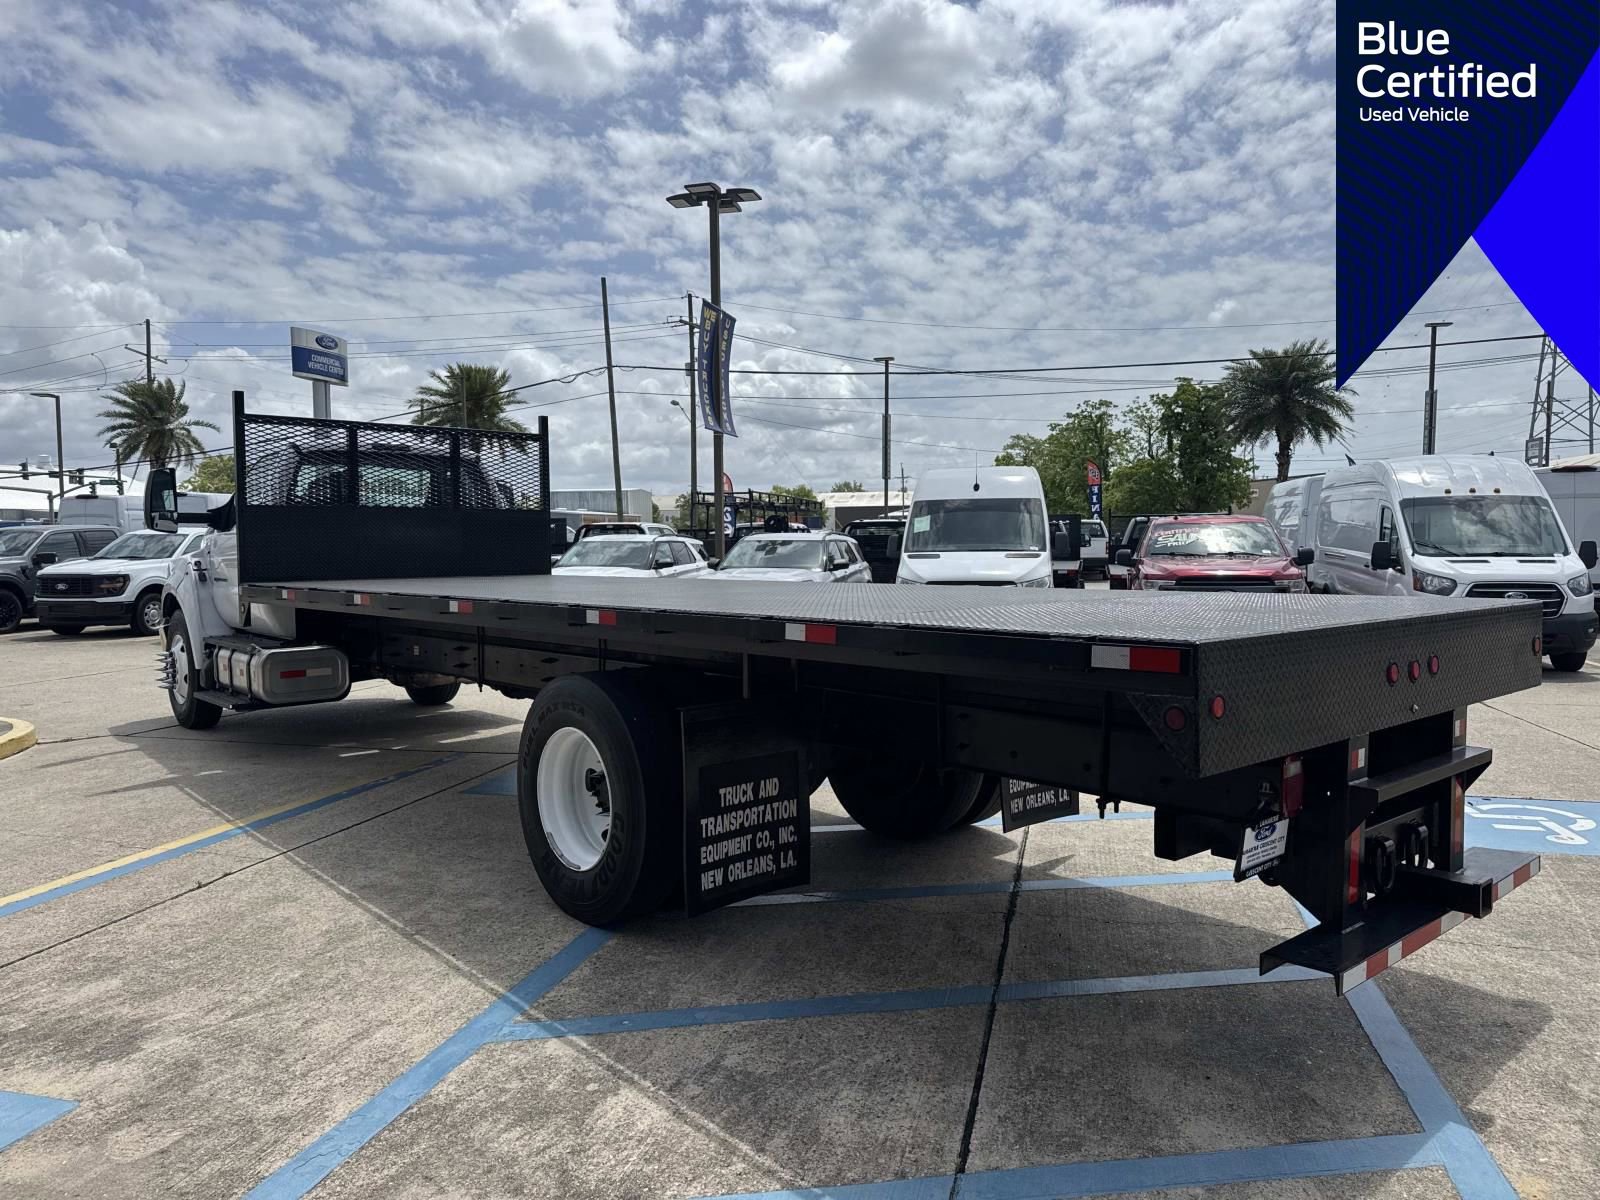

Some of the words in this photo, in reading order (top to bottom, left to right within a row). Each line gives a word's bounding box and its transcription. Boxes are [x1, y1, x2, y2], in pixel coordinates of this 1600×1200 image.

[704, 307, 716, 321] WE
[703, 320, 711, 353] BUY
[702, 359, 714, 426] TRUCKS
[719, 782, 754, 808] TRUCK
[759, 777, 780, 800] AND
[1010, 798, 1024, 815] NEW
[1026, 790, 1057, 809] ORLEANS,
[1059, 788, 1070, 802] LA.
[701, 799, 798, 838] TRANSPORTATION
[701, 834, 753, 865] EQUIPMENT
[756, 830, 775, 850] CO.,
[779, 825, 798, 843] INC.
[701, 867, 724, 891] NEW
[728, 854, 776, 882] ORLEANS,
[780, 850, 798, 868] LA.
